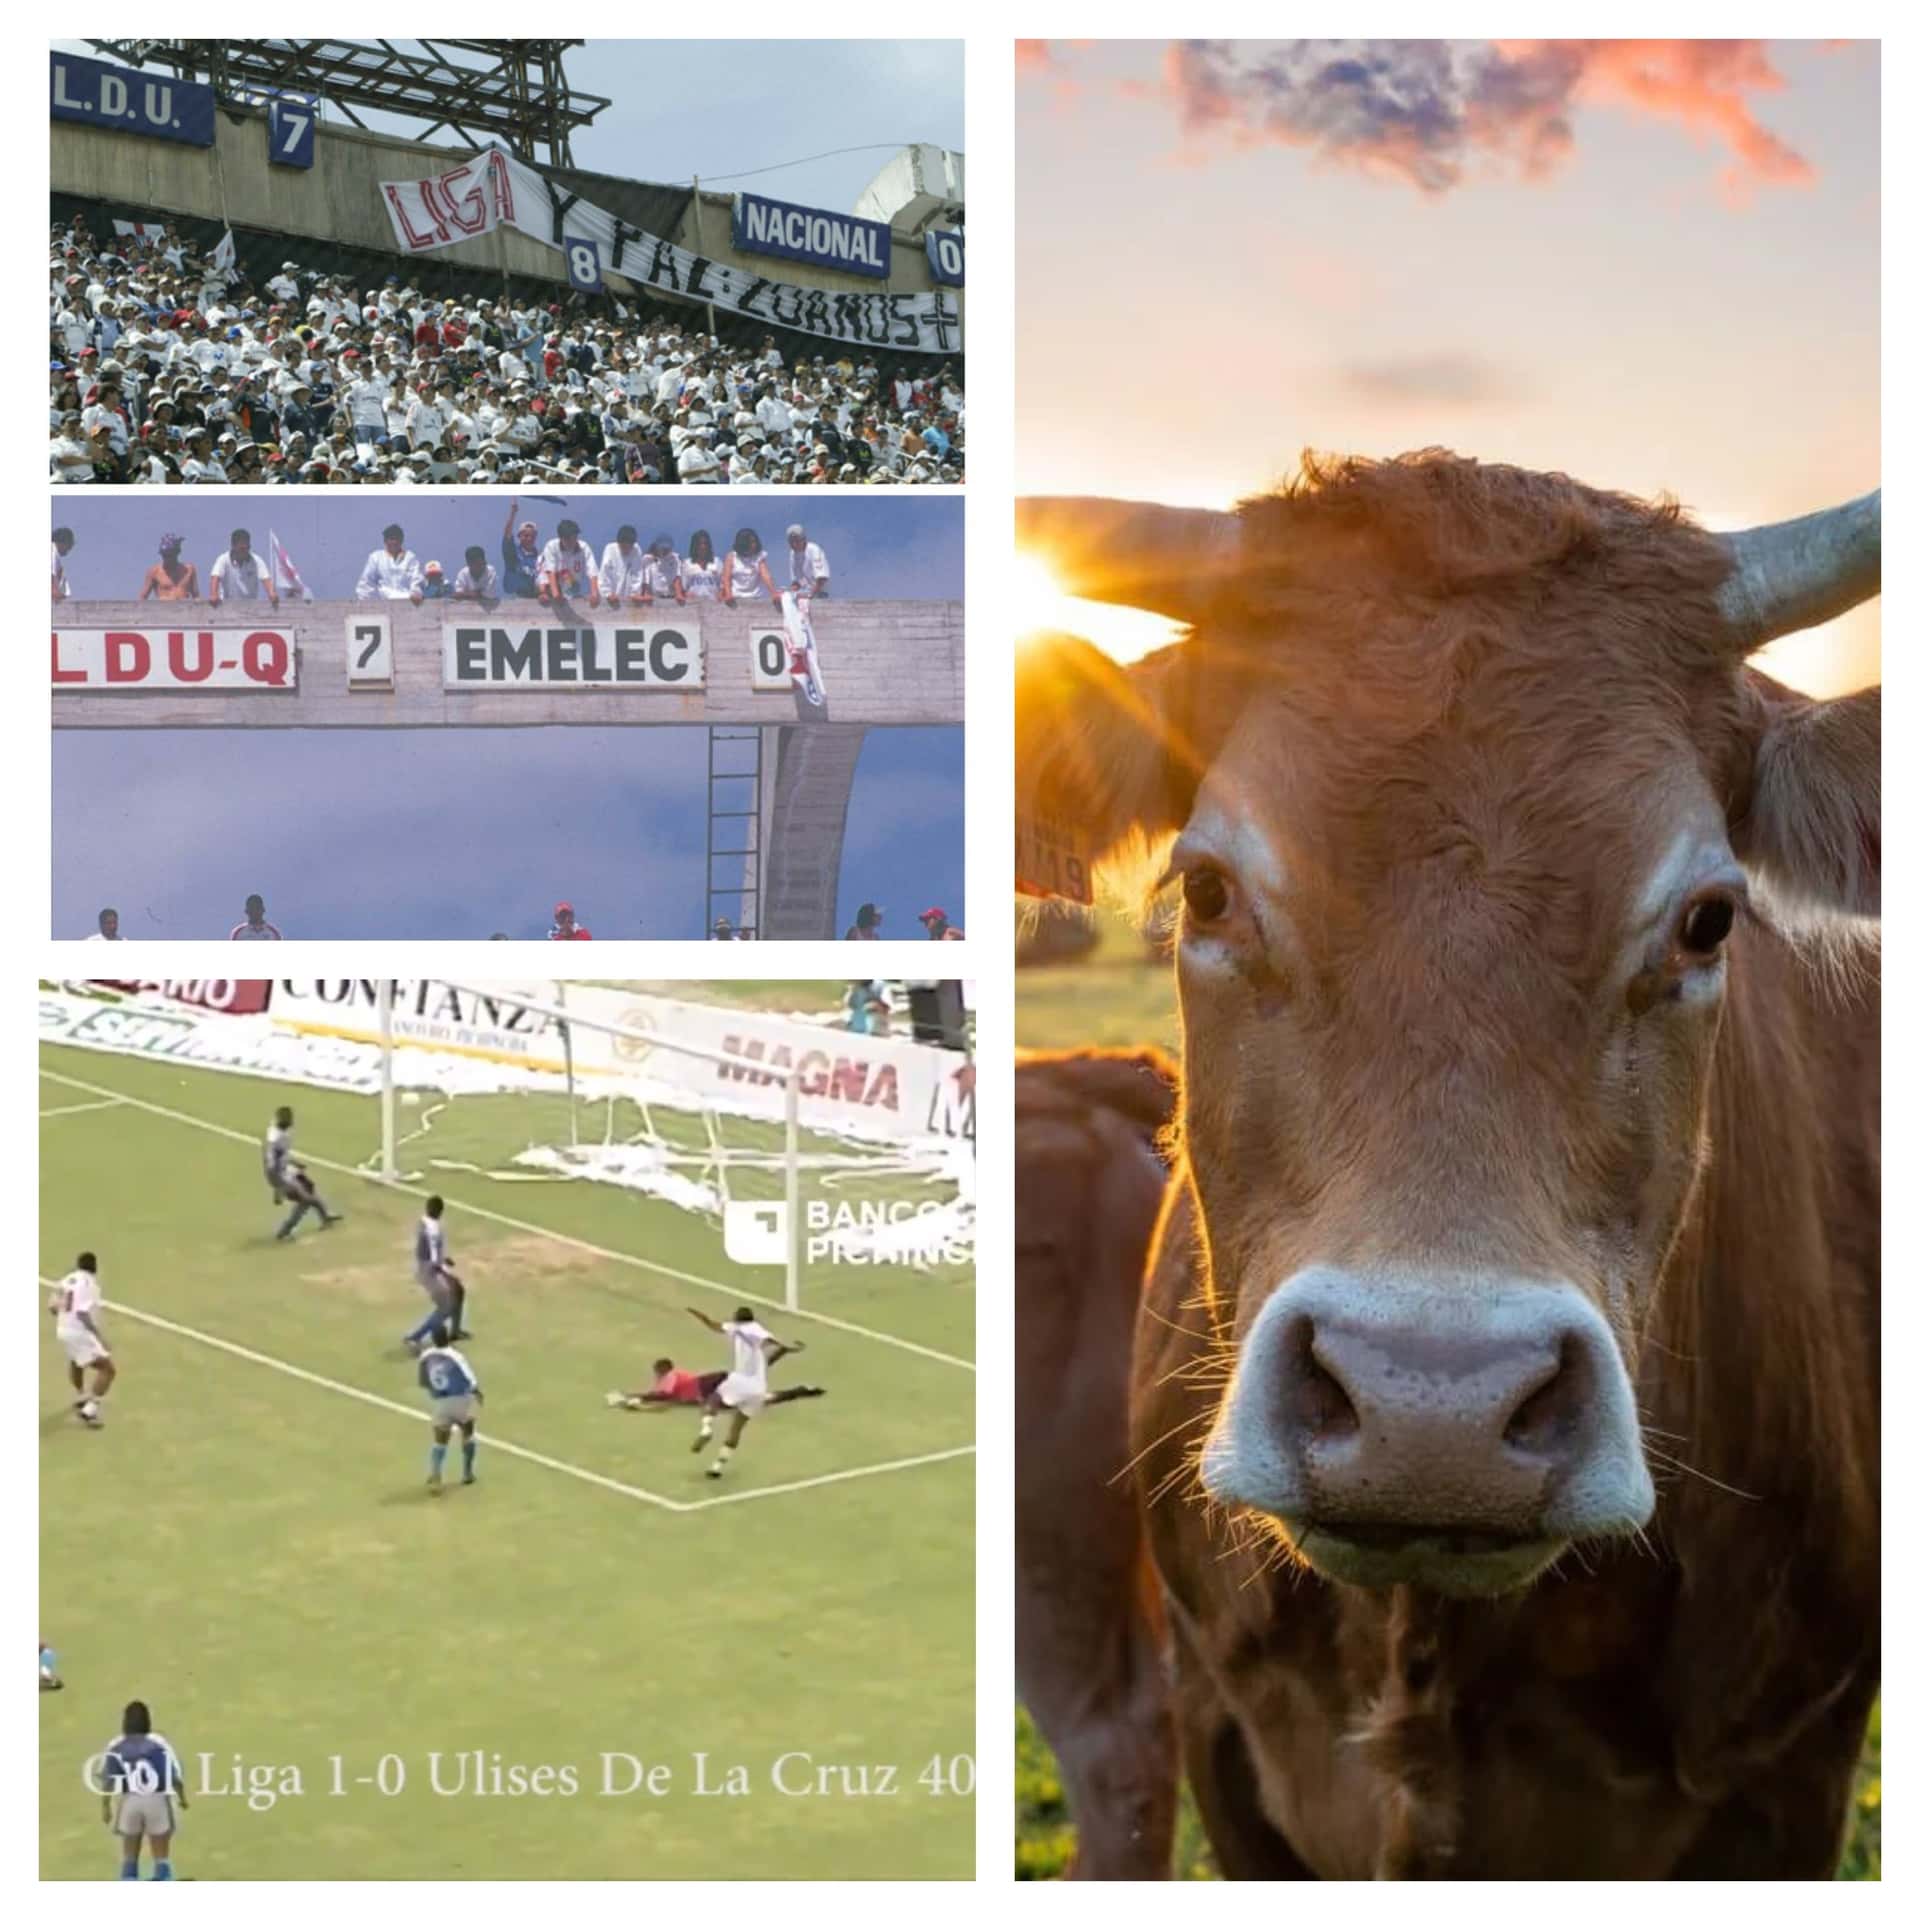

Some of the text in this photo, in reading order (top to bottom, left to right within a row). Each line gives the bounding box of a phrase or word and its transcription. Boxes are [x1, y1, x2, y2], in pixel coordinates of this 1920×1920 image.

[282, 113, 309, 153] 7
[385, 150, 515, 249] LIGA
[543, 177, 580, 246] Y
[747, 202, 885, 268] NACIONAL
[939, 238, 962, 275] 0
[570, 246, 598, 285] 8
[354, 625, 382, 669] 7
[456, 628, 689, 681] EMELEC
[759, 634, 786, 676] 0
[717, 1035, 899, 1110] MAGNA
